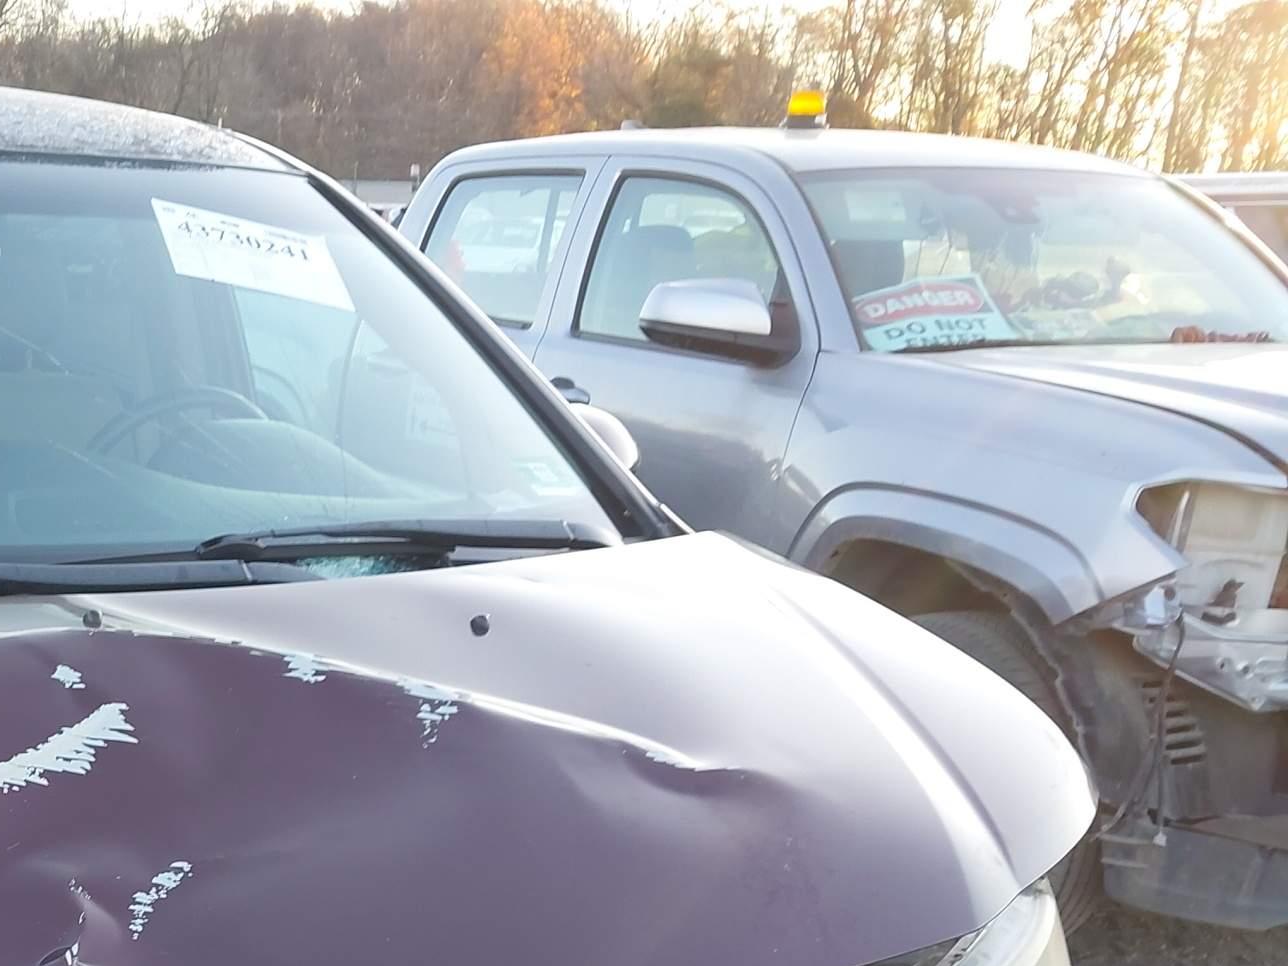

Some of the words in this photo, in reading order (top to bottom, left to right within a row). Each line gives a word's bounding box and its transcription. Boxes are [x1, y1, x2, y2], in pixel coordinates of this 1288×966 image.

[177, 220, 309, 262] 43730241
[863, 289, 975, 319] DANGER
[884, 320, 926, 341] DO
[934, 317, 987, 332] NOT
